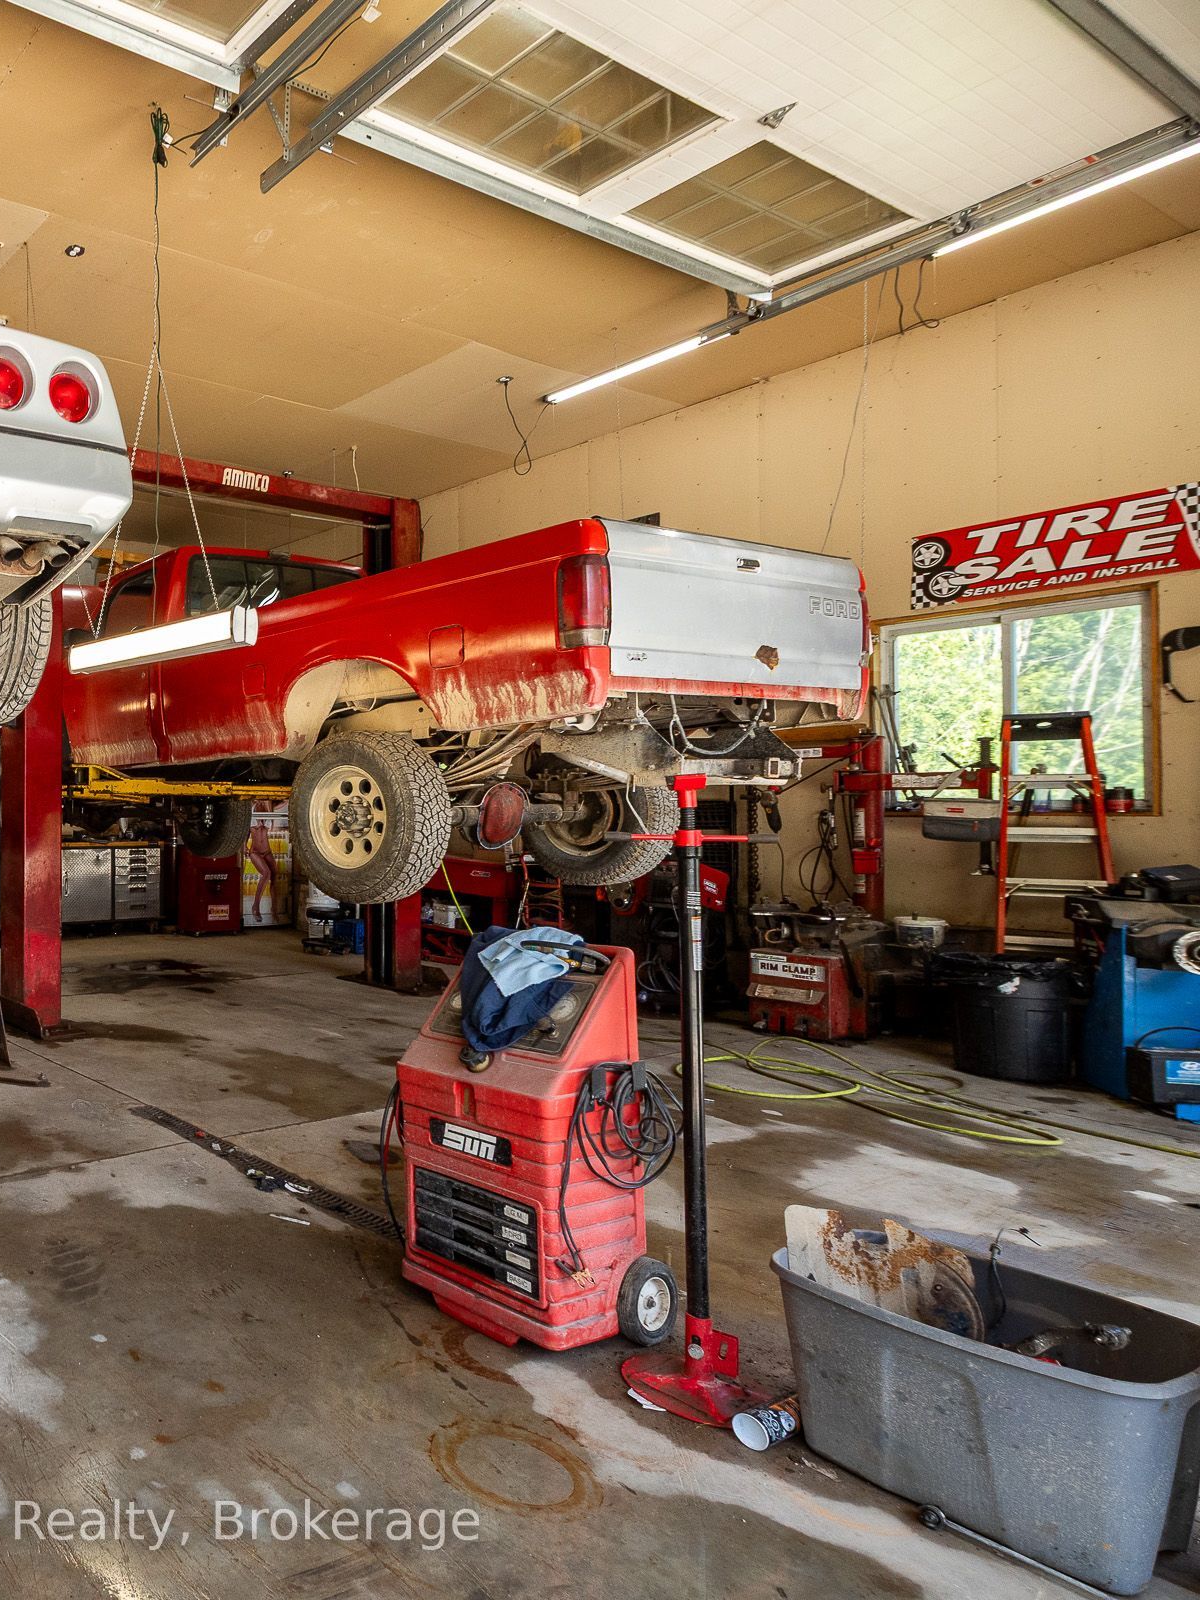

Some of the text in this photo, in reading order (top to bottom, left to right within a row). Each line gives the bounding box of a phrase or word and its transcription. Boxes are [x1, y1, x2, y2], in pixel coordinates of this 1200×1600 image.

[221, 467, 270, 493] AMMCO
[966, 492, 1177, 555] TIRE
[950, 523, 1184, 585] SALE
[962, 558, 1180, 598] SERVICE AND INSTALL
[808, 596, 861, 620] FORD
[760, 962, 816, 975] RIM CLAMP
